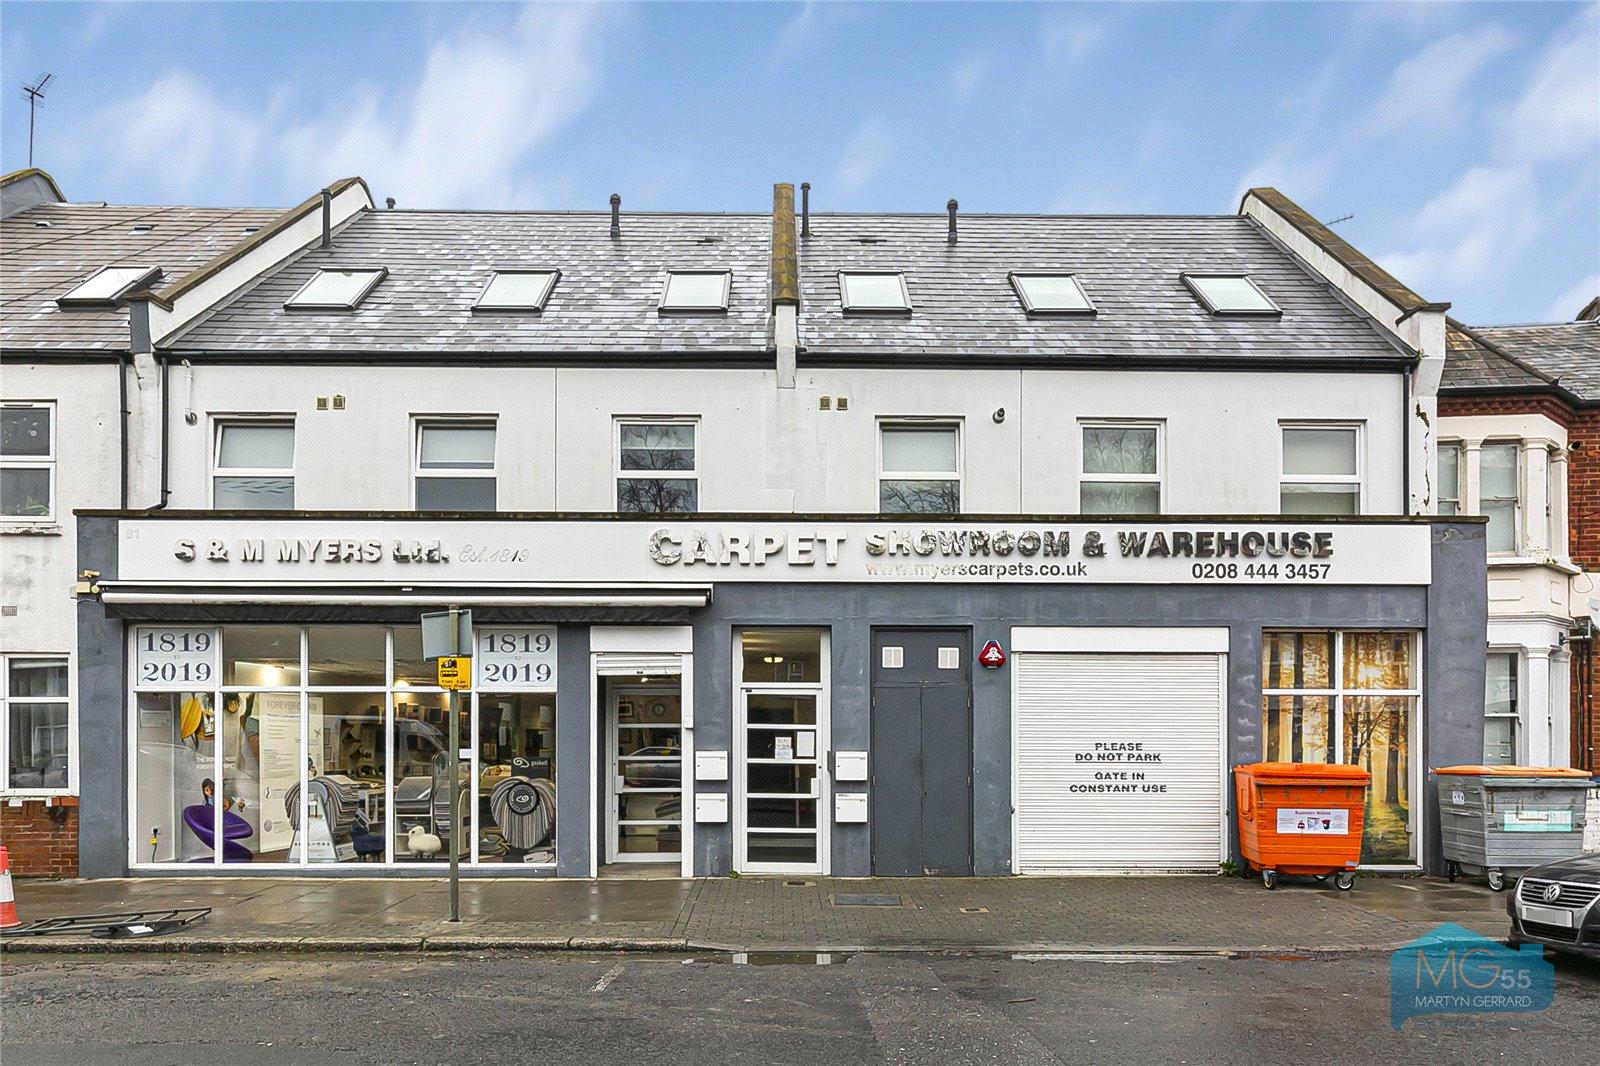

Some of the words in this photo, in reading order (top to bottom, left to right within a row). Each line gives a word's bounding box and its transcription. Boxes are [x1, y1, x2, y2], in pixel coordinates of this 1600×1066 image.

[174, 537, 197, 562] S
[205, 538, 229, 562] &
[239, 538, 265, 562] M
[275, 538, 382, 563] MYERS
[393, 538, 450, 564] Ltd.
[648, 528, 847, 567] CARPET
[865, 529, 1071, 558] SHOWROOM
[1082, 530, 1108, 558] &
[1116, 531, 1334, 559] WAREHOUSE
[865, 562, 1088, 579] www.myerscarpets.co.uk
[1191, 563, 1238, 580] 0208
[1244, 563, 1279, 580] 444
[1285, 563, 1332, 580] 3457
[142, 632, 212, 652] 1819
[483, 633, 552, 653] 1819
[142, 662, 212, 682] 2019
[483, 663, 552, 682] 2019
[1094, 742, 1143, 751] PLEASE
[1075, 752, 1093, 761] DO
[1097, 752, 1123, 761] NOT
[1127, 752, 1162, 762] PARK
[1094, 771, 1128, 780] GATE
[1131, 772, 1145, 780] IN
[1069, 784, 1138, 793] CONSTANT
[1142, 784, 1168, 793] USE
